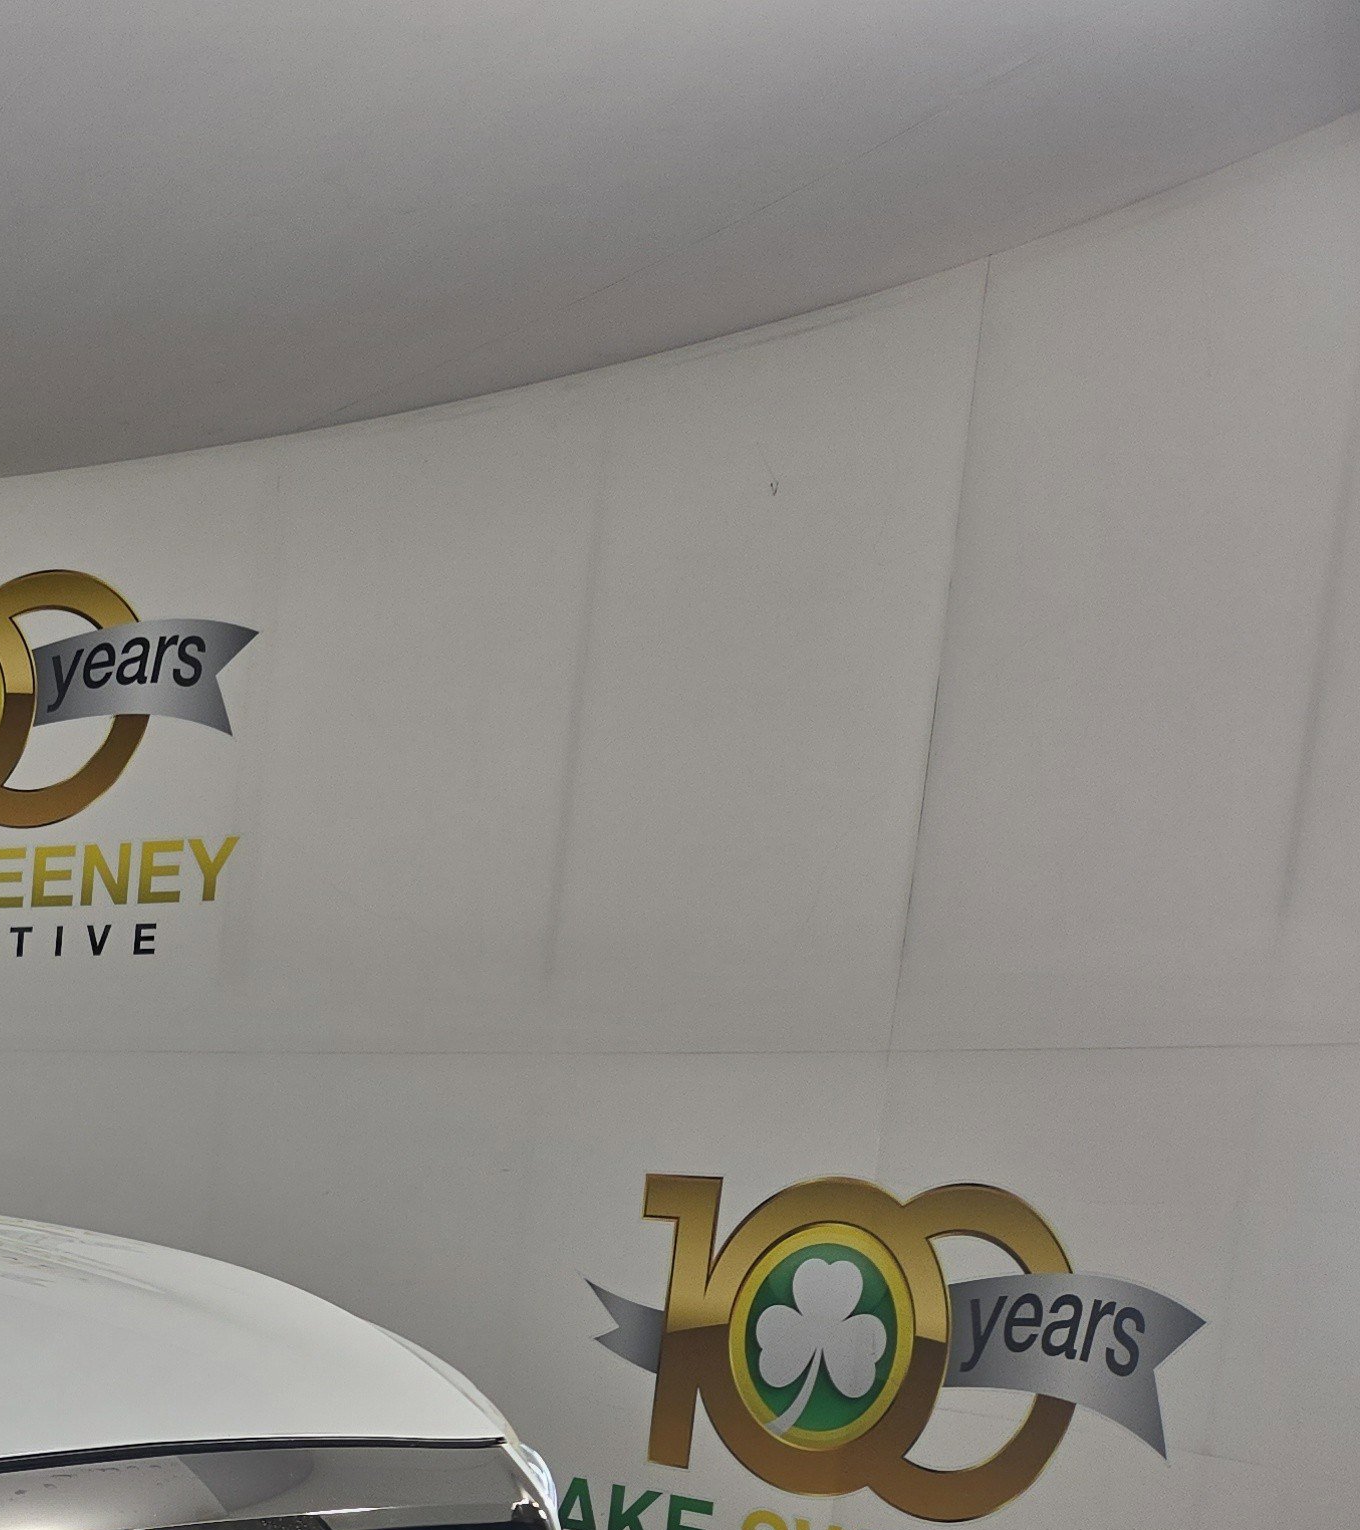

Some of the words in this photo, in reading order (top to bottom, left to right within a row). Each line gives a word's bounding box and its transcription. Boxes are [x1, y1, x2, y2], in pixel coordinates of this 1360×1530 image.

[45, 628, 208, 714] years
[641, 1173, 1074, 1522] 100
[959, 1291, 1147, 1378] years
